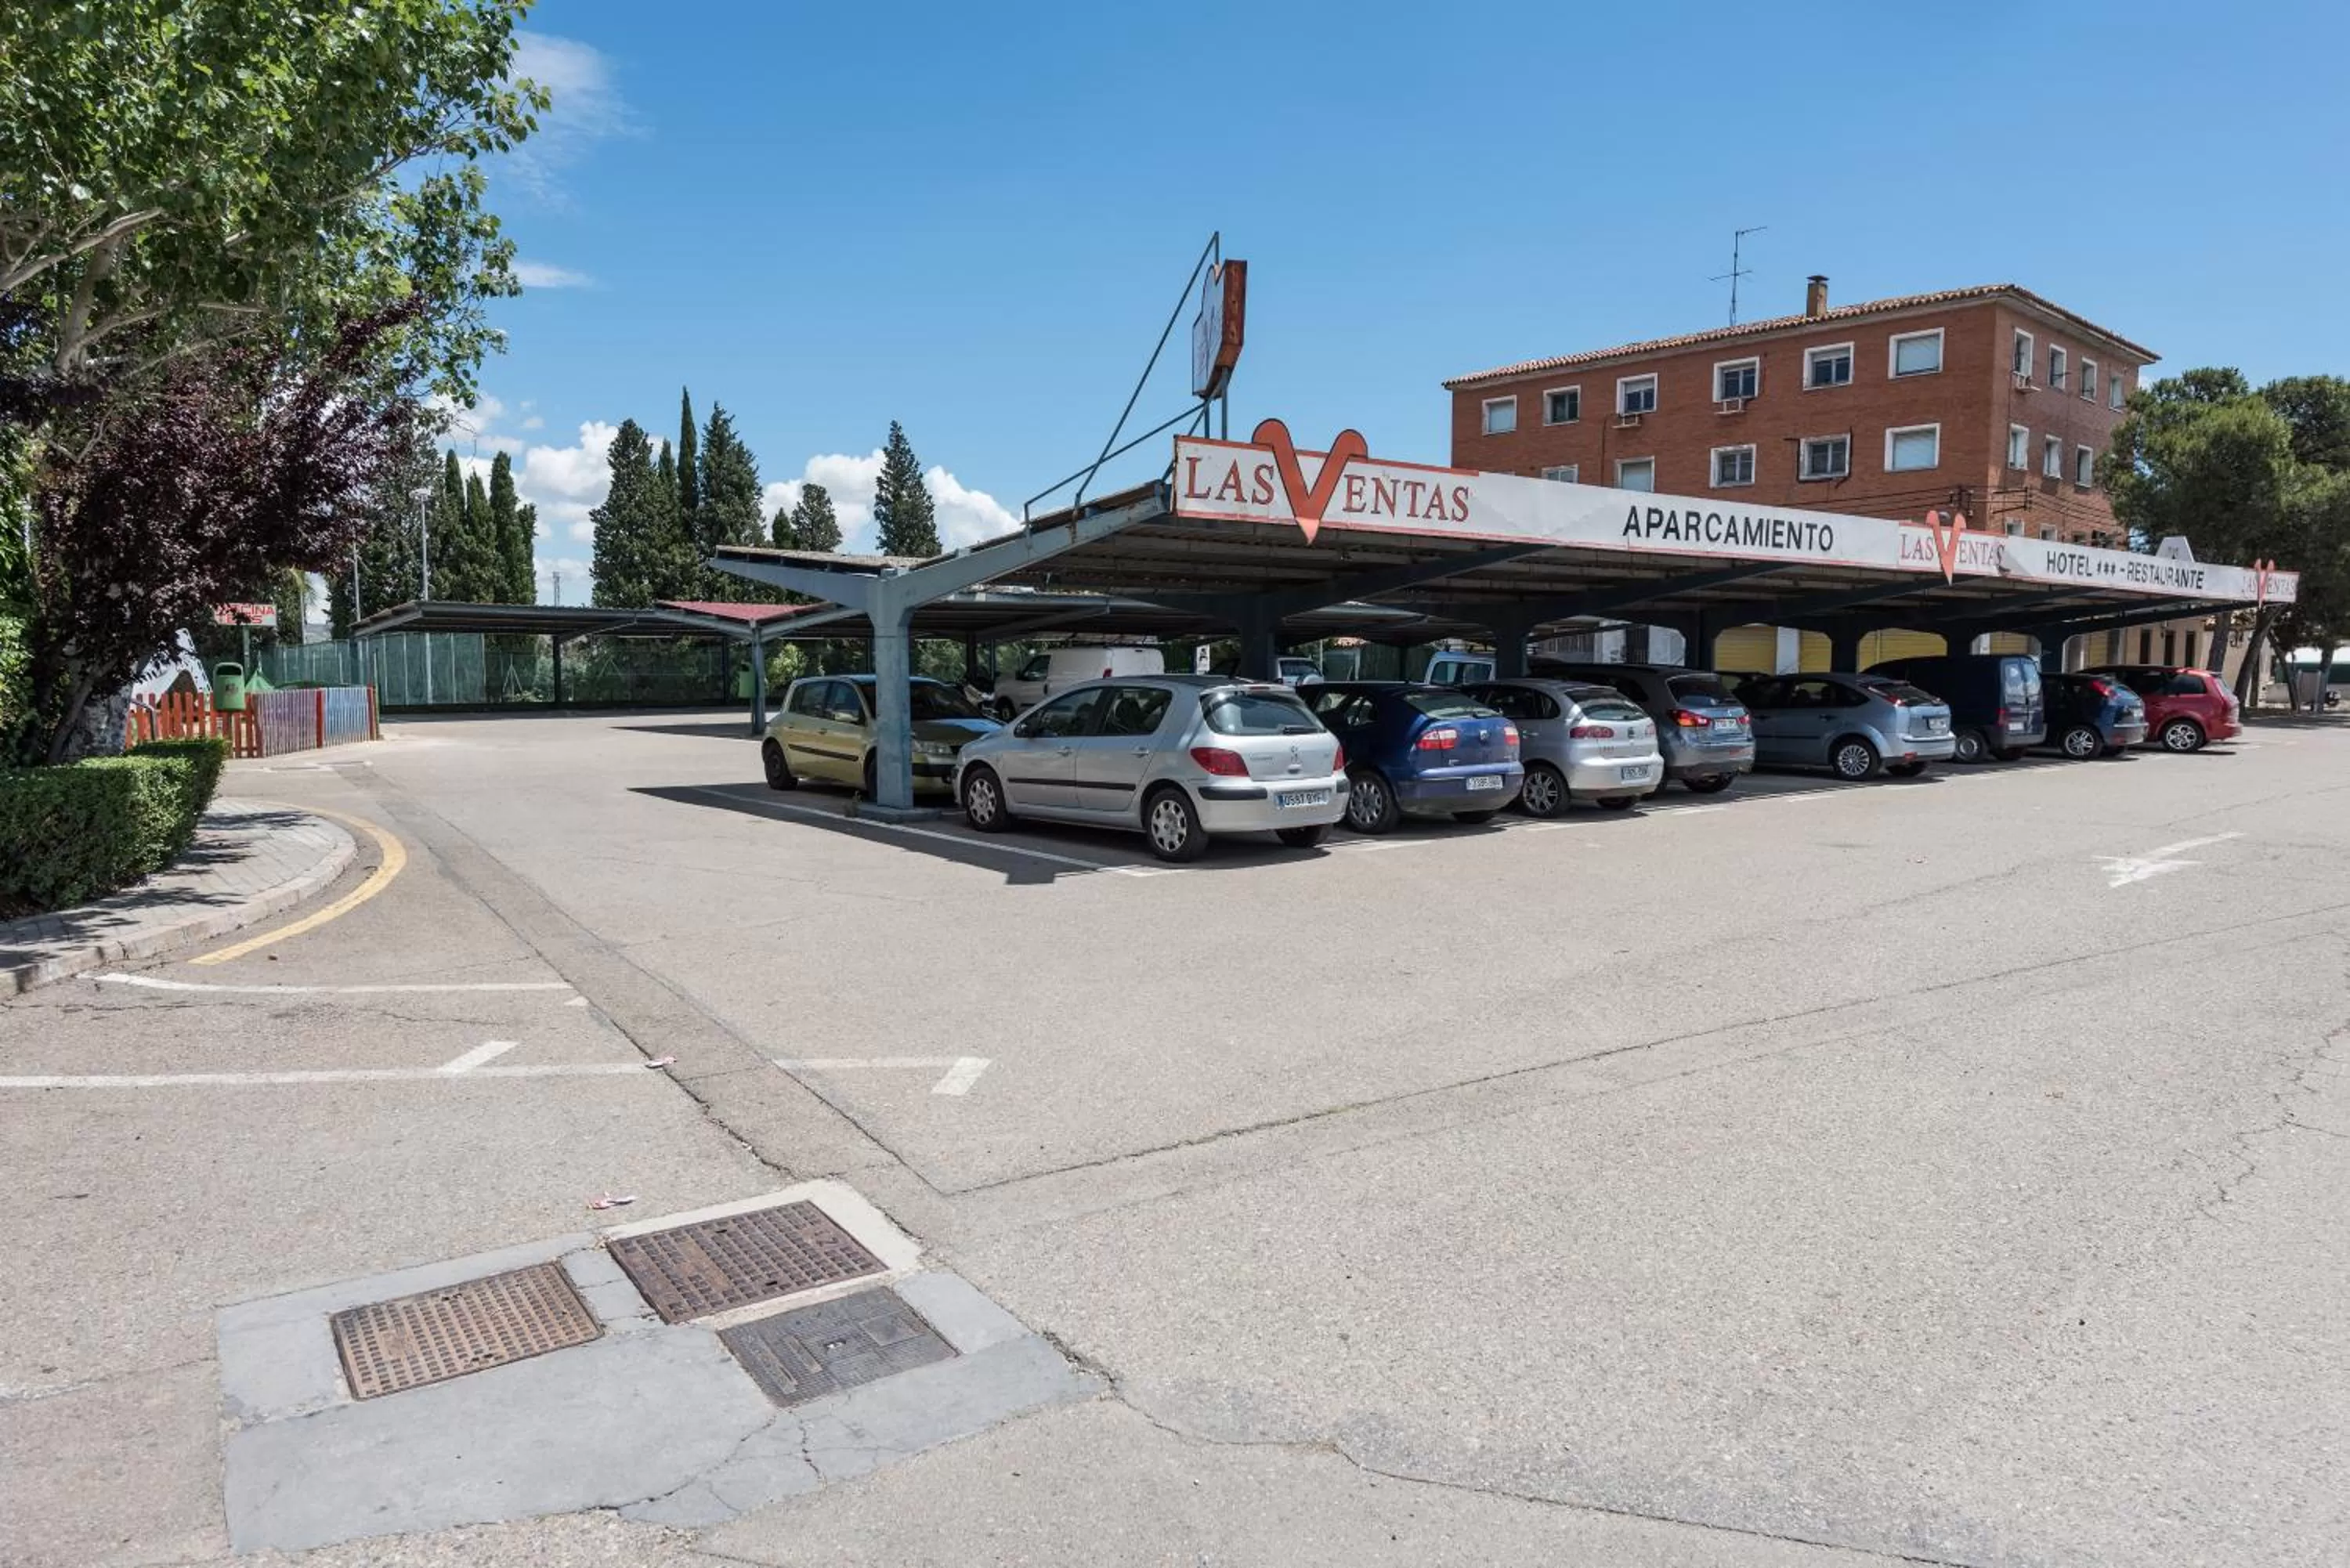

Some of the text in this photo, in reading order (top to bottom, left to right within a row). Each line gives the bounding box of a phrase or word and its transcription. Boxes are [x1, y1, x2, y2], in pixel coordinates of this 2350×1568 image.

[1184, 417, 1470, 546] LAS VENTAS
[1623, 506, 1834, 551] APARCAMIENTO
[1900, 510, 2005, 587] LAS VENTAS
[2047, 551, 2092, 576] HOTEL
